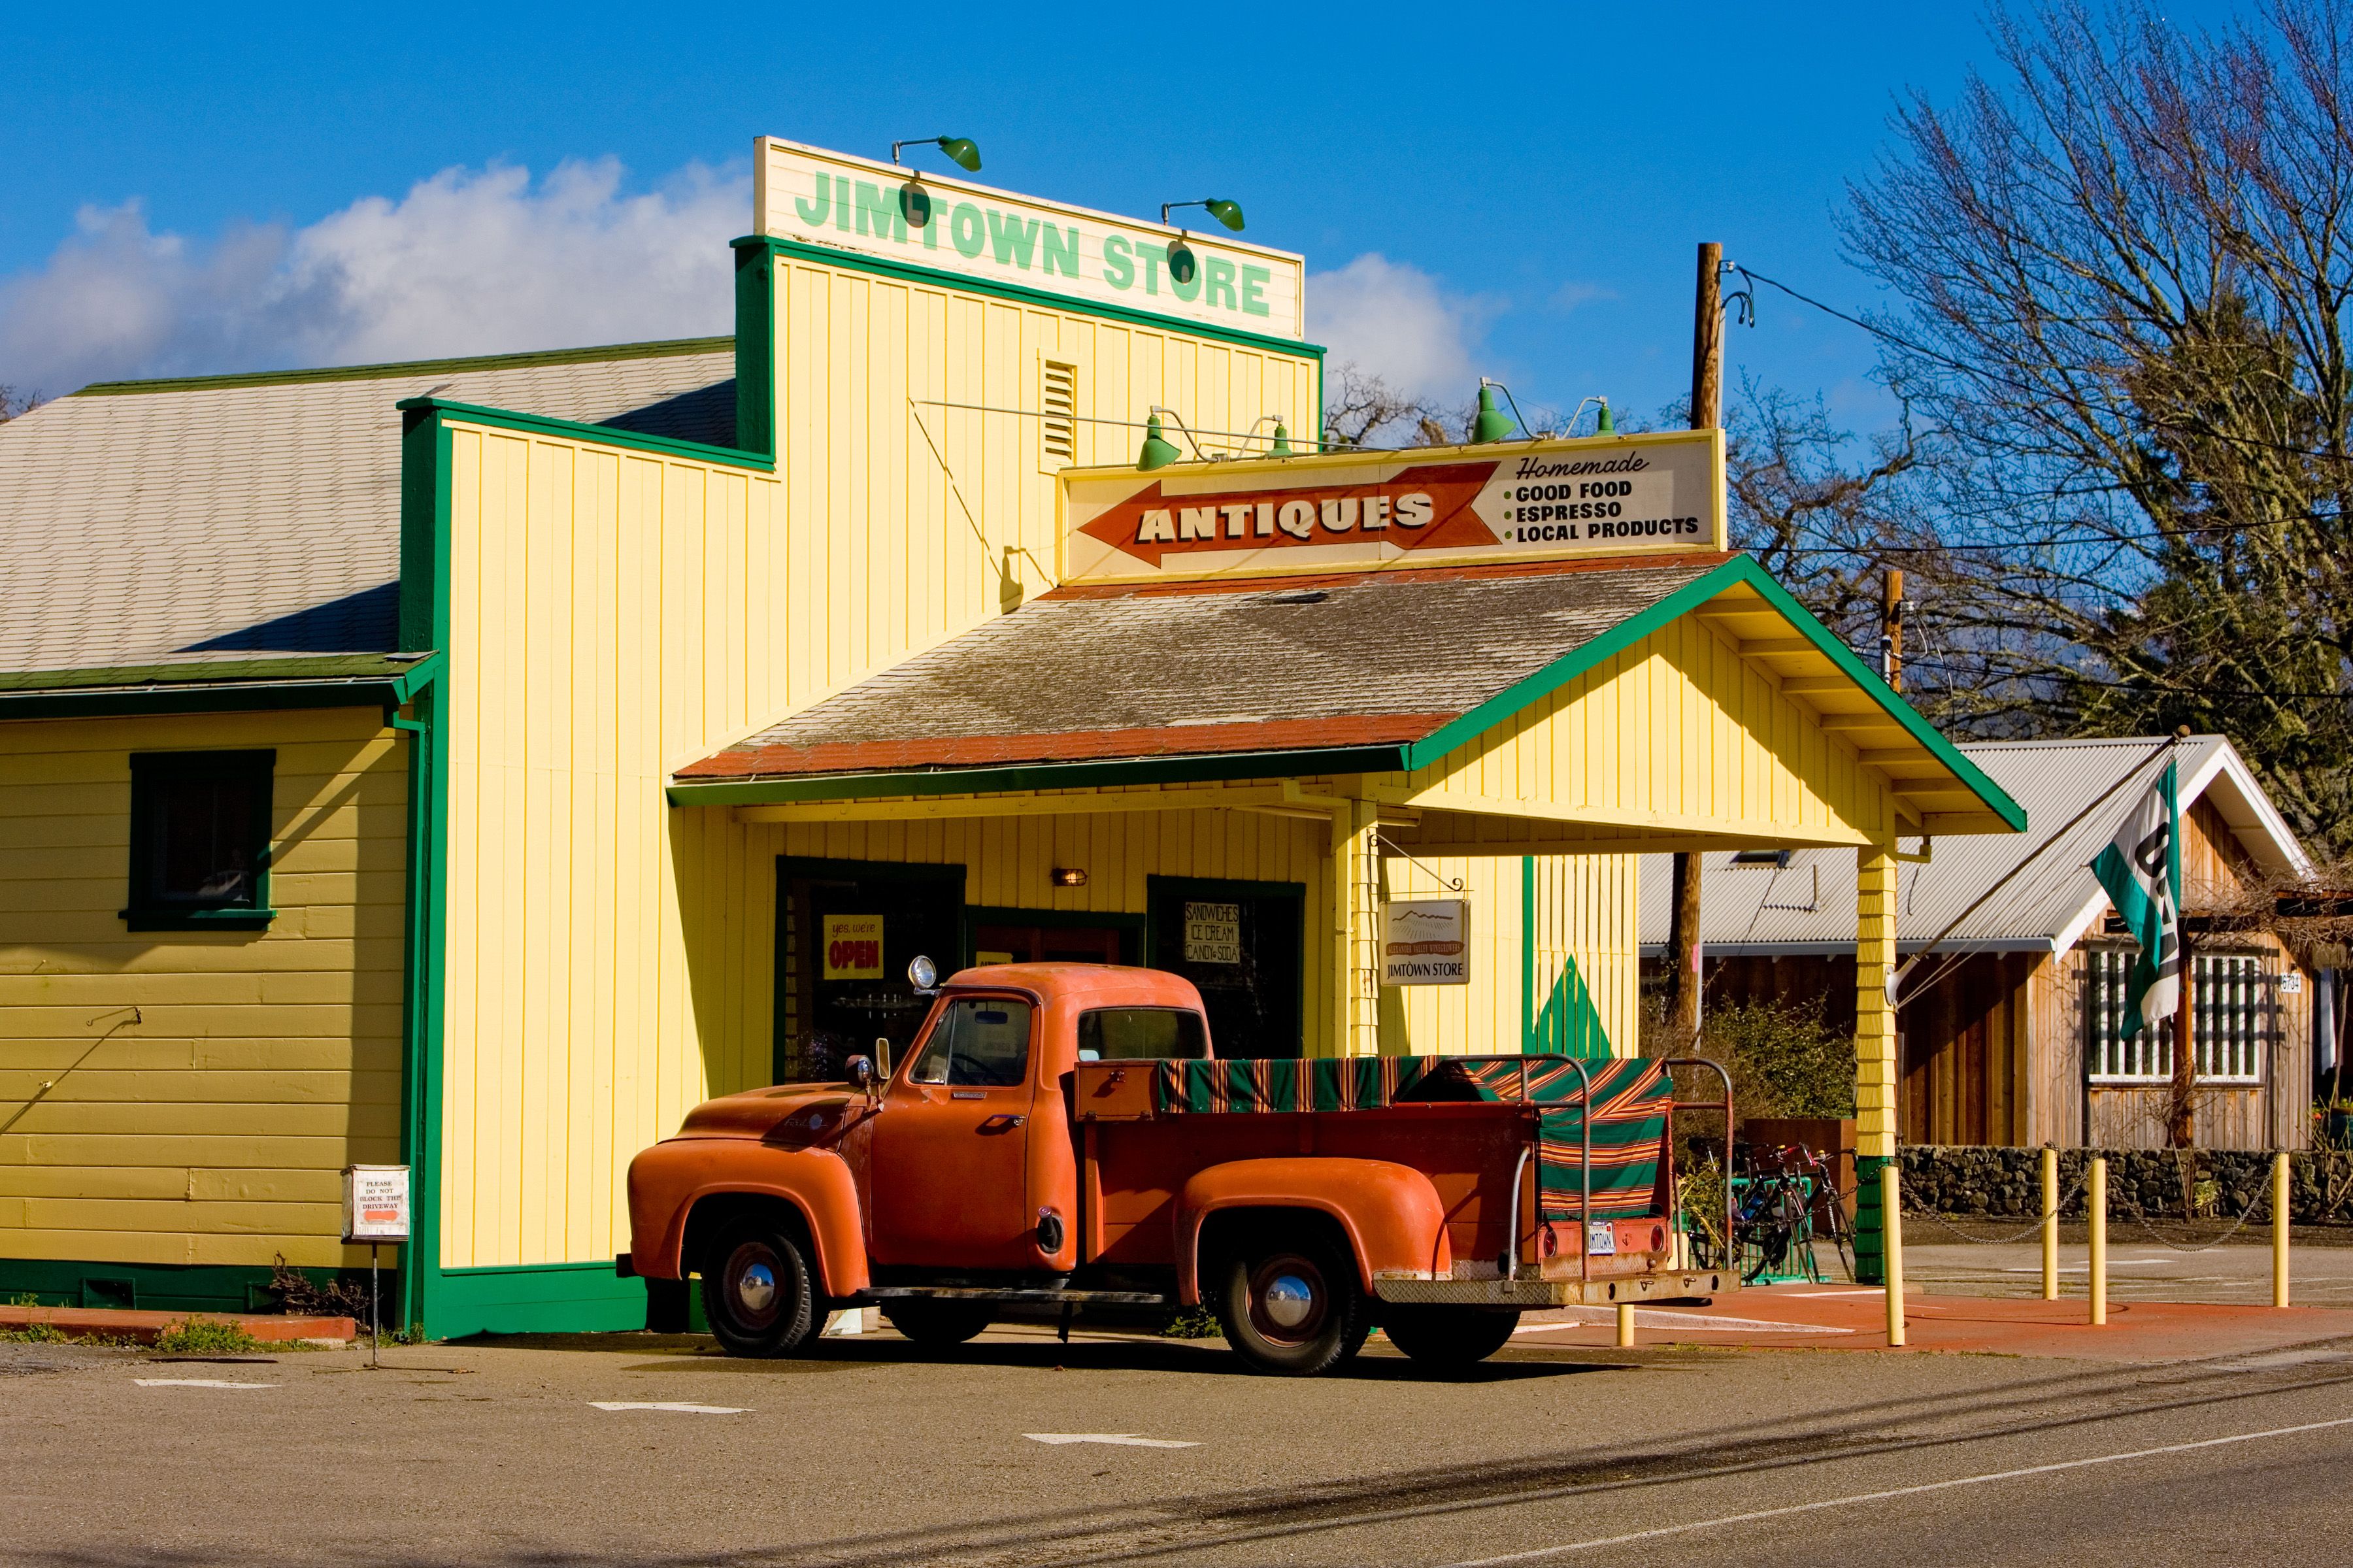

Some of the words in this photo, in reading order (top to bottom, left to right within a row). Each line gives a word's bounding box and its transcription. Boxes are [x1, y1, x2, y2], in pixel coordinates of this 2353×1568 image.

[794, 171, 1080, 280] JIMTOWN
[1103, 235, 1271, 318] STORE
[1516, 450, 1650, 480] Homemade
[1516, 484, 1571, 502] GOOD
[1580, 480, 1632, 499] FOOD
[1134, 493, 1435, 544] ANTIQUES
[1516, 501, 1622, 523] ESPRESSO
[1517, 524, 1579, 542] LOCAL
[1588, 517, 1699, 539] PRODUCTS
[1186, 903, 1239, 922] SANDWICHES
[852, 922, 876, 933] we're
[1191, 924, 1203, 940] ICE
[1205, 925, 1234, 941] CREAM
[829, 940, 879, 970] OPEN
[1218, 945, 1238, 961] SODA
[1433, 962, 1463, 976] STORE
